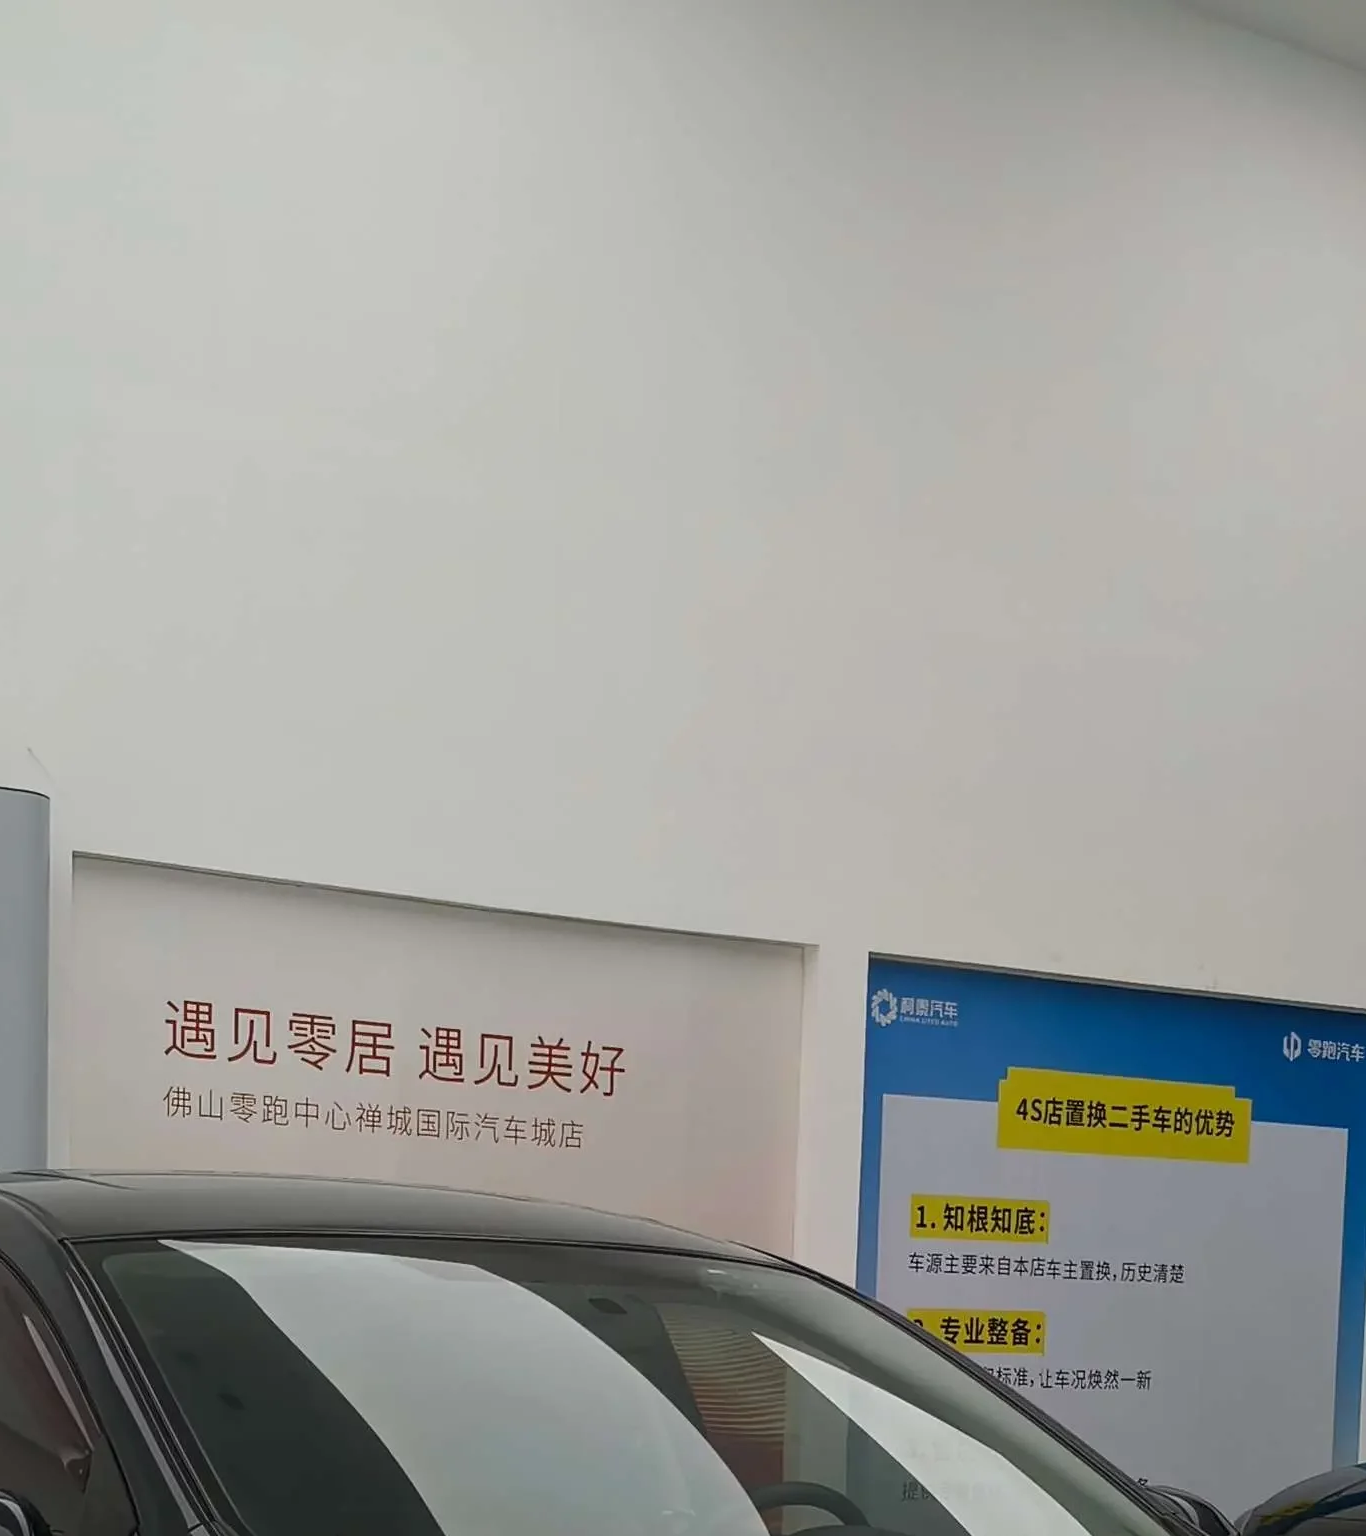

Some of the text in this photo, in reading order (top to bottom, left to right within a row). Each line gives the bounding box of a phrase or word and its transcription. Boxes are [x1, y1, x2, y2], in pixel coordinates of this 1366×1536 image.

[163, 1000, 626, 1097] 遇见零居 遇见美好
[1307, 1039, 1365, 1062] 零跑汽车
[162, 1086, 583, 1149] 佛山零跑中心禅城国际汽车城店
[1015, 1097, 1235, 1138] 4S店置换二手车的优势
